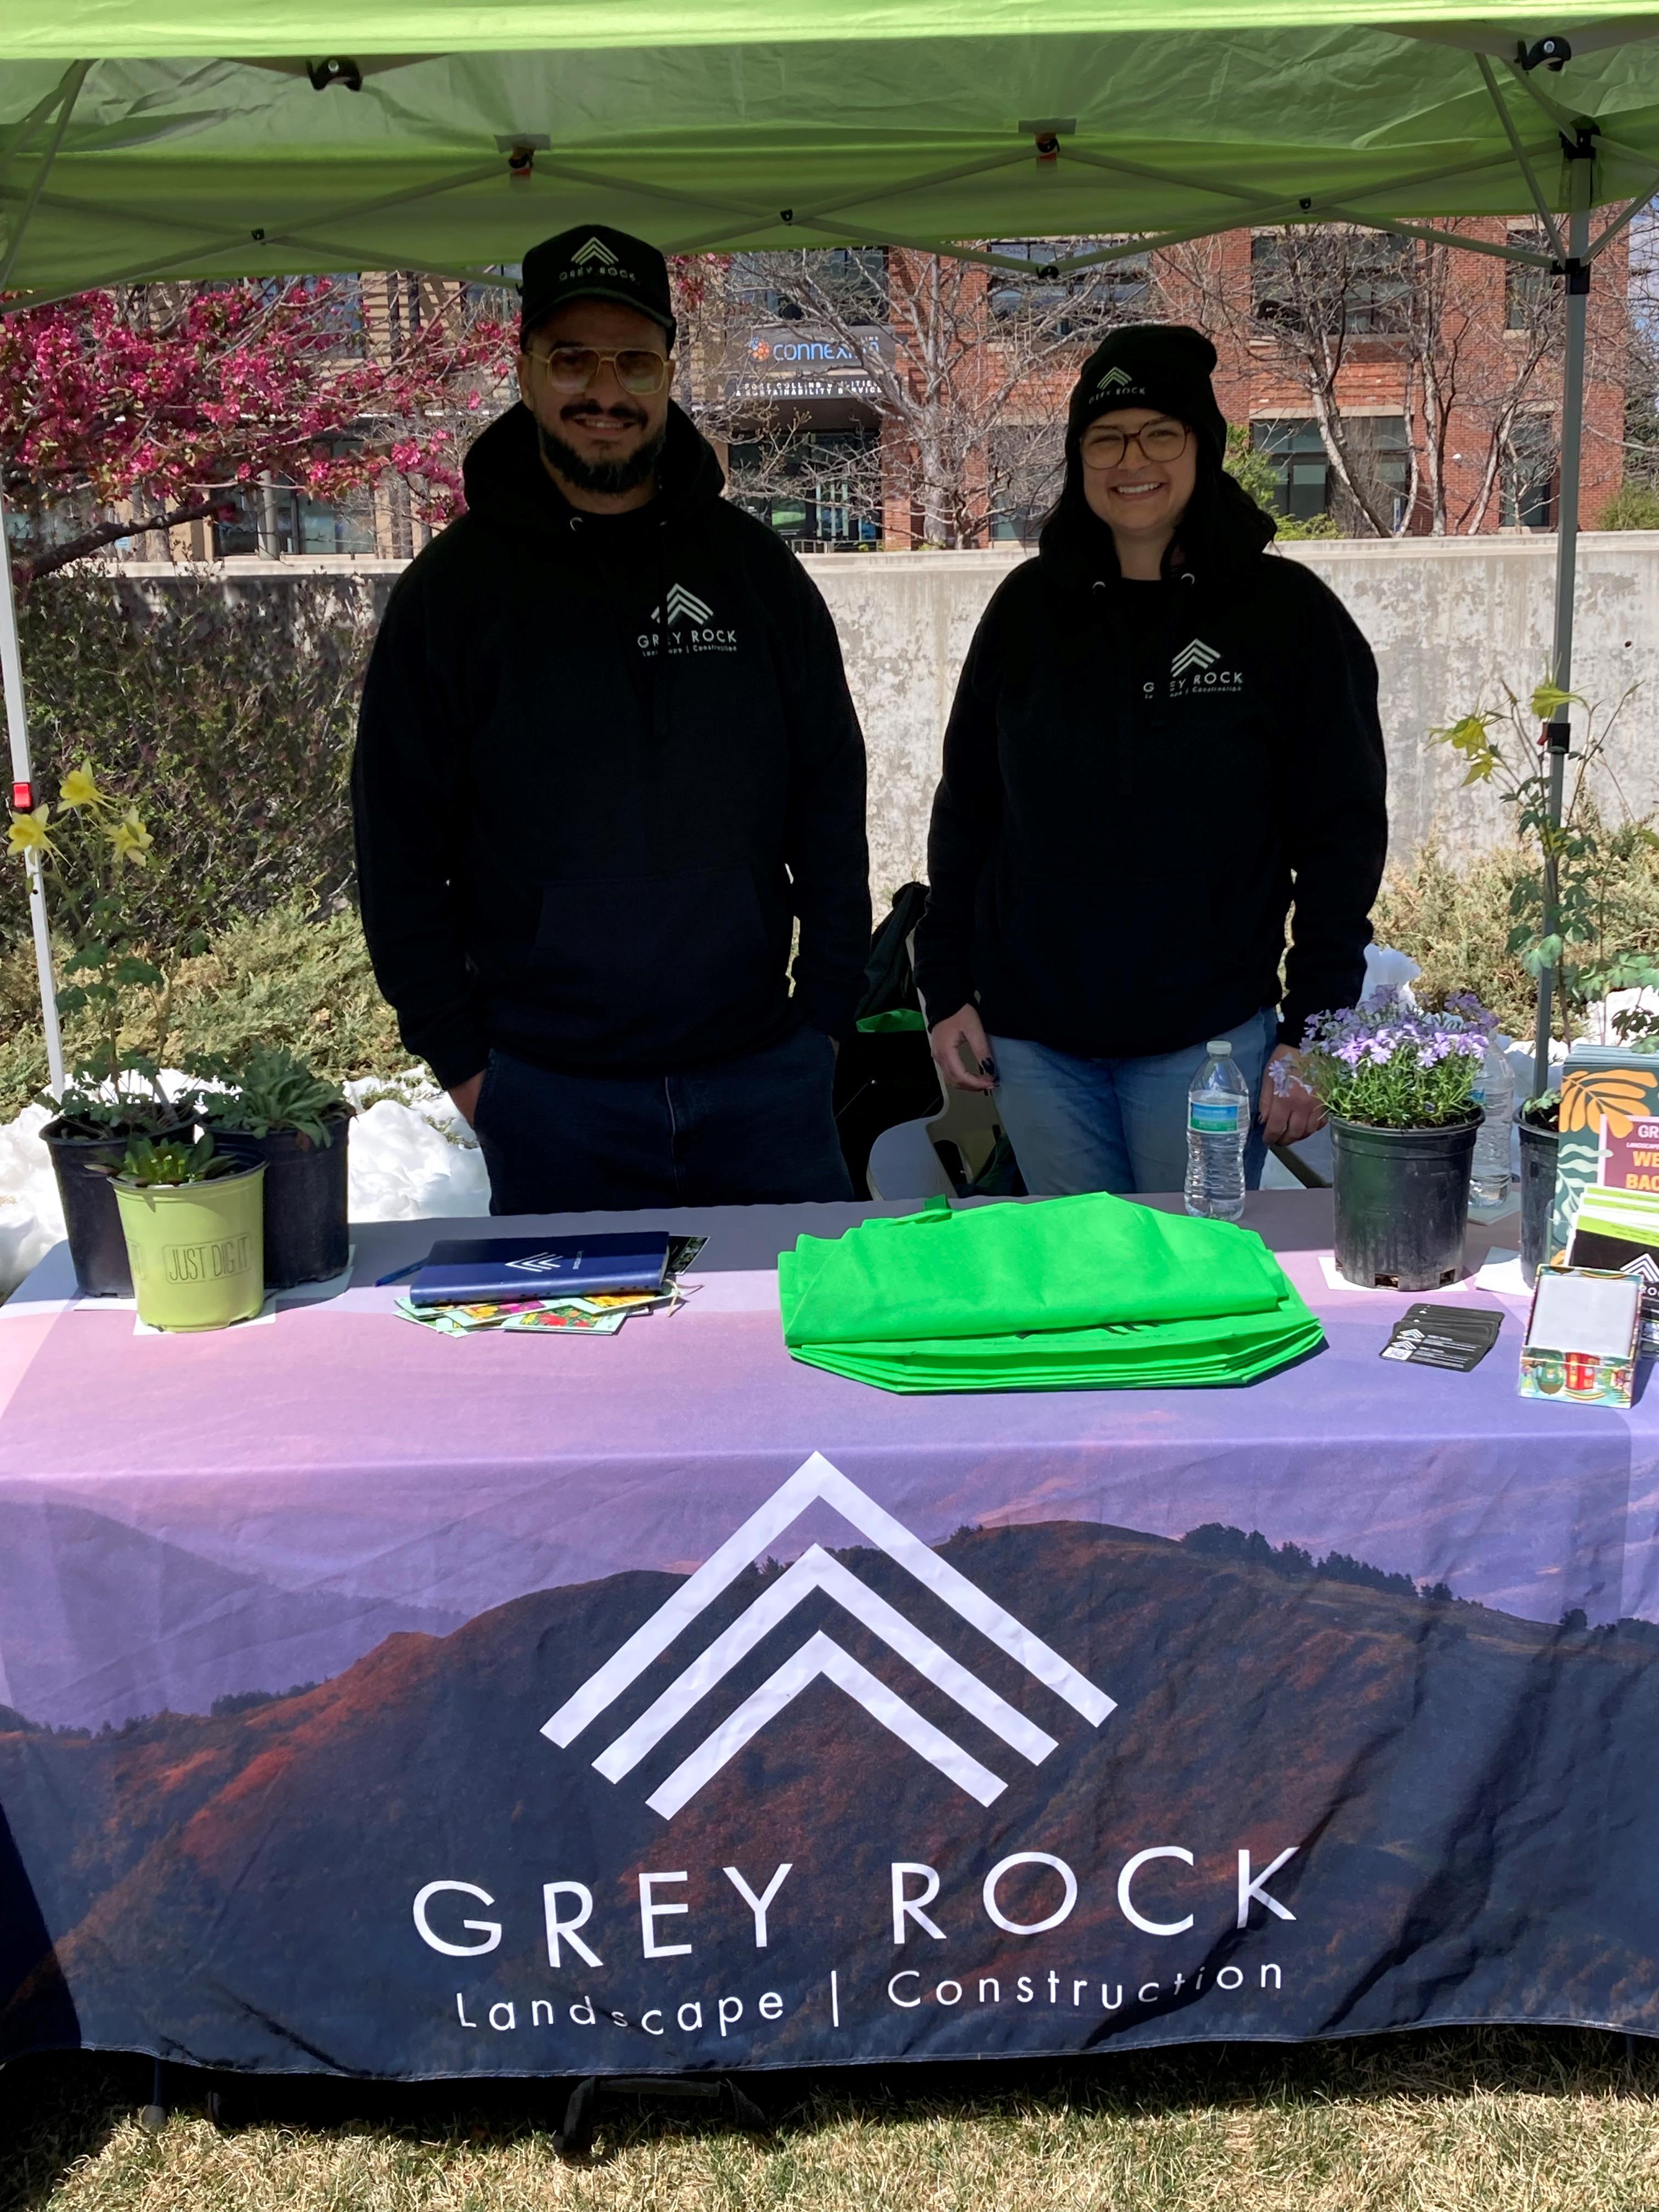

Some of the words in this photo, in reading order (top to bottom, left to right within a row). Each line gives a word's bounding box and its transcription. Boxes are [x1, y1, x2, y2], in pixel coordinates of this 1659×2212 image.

[637, 631, 681, 648] GRY
[691, 629, 737, 643] ROCK
[1143, 678, 1187, 693] GEY
[1193, 672, 1243, 685] ROCK
[170, 1246, 206, 1281] JUST
[212, 1241, 235, 1277] DIG
[237, 1237, 248, 1270] IT
[413, 1864, 792, 1967] GREY
[891, 1846, 1299, 1944] ROCK
[457, 1992, 783, 2036] Landscape
[888, 1963, 1281, 2009] Construction
